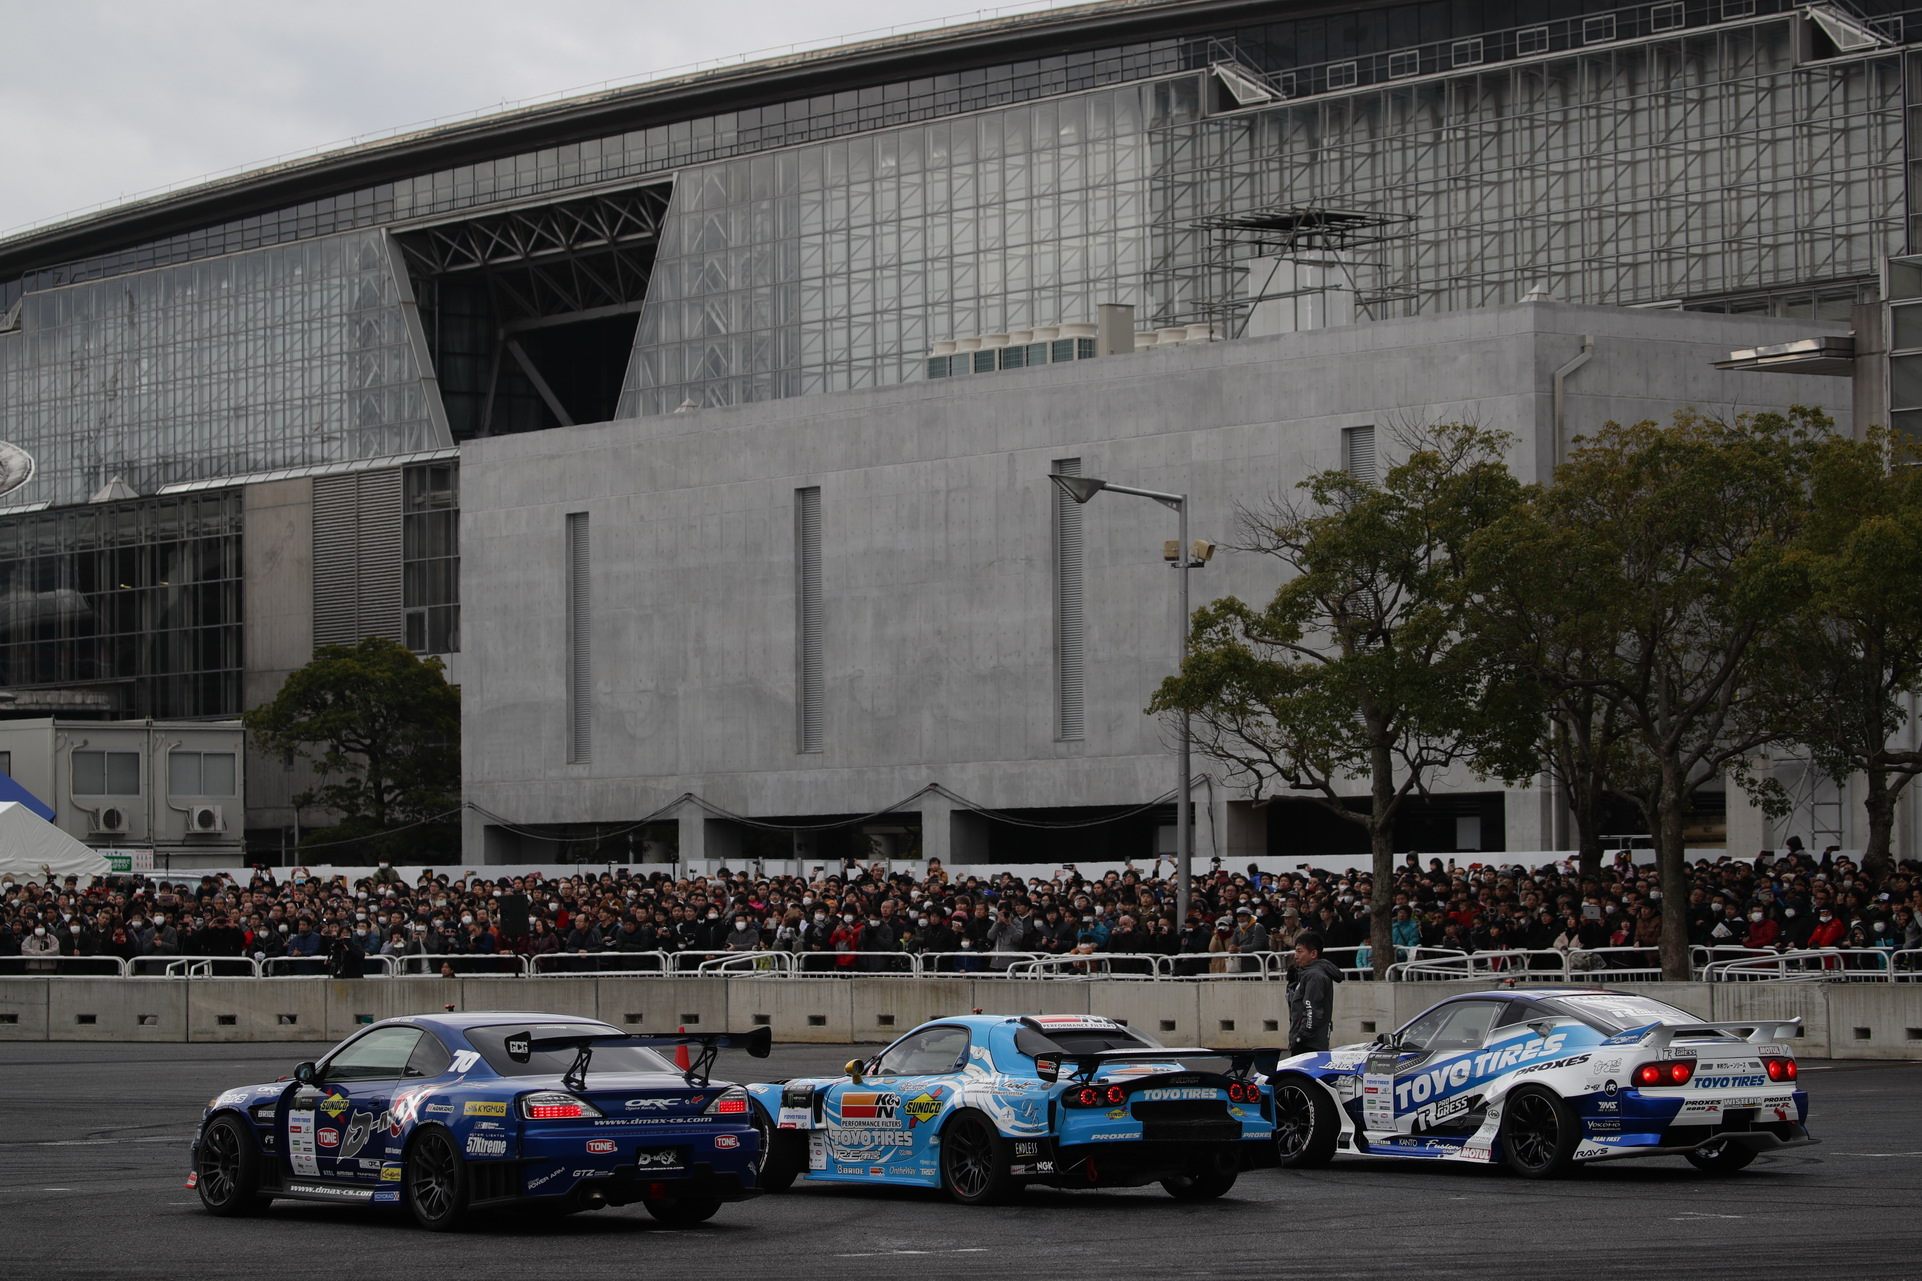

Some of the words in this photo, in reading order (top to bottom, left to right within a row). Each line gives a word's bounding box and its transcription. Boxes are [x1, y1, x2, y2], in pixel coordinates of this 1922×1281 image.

[1759, 1046, 1780, 1054] MOTUL
[448, 1049, 481, 1073] 70
[1512, 1053, 1592, 1079] PROXES
[1395, 1059, 1472, 1110] TOYO
[1474, 1033, 1567, 1078] TIRES
[1694, 1076, 1732, 1088] TOYO
[1732, 1075, 1766, 1087] TIRES
[1143, 1088, 1181, 1101] TOYO
[1181, 1088, 1218, 1099] TIRES
[321, 1100, 349, 1110] SUNOCO
[624, 1098, 682, 1110] ORC
[1437, 1097, 1450, 1107] PRO
[1723, 1096, 1762, 1105] WISTERIA
[906, 1102, 941, 1114] SUNOCO
[1437, 1097, 1468, 1116] GRESS
[258, 1110, 276, 1118] BRIDE
[594, 1116, 712, 1125] www.dmax-cs.com
[841, 1120, 881, 1128] PERFORMANCE
[881, 1120, 902, 1128] FILTERS
[319, 1132, 337, 1143] TONE
[831, 1130, 874, 1146] TOYO
[874, 1130, 913, 1147] TIRES
[1091, 1132, 1141, 1140] PROXES
[466, 1136, 507, 1154] 57Xtreme
[589, 1142, 613, 1151] TONE
[717, 1138, 736, 1146] TONE
[1399, 1138, 1418, 1147] KANTO
[1015, 1142, 1038, 1154] ENDLESS
[1575, 1147, 1609, 1159] RAYS
[1460, 1148, 1491, 1159] MOTUL
[843, 1166, 864, 1175] BRIDE
[1036, 1161, 1054, 1170] NGK
[572, 1169, 595, 1177] GTZ
